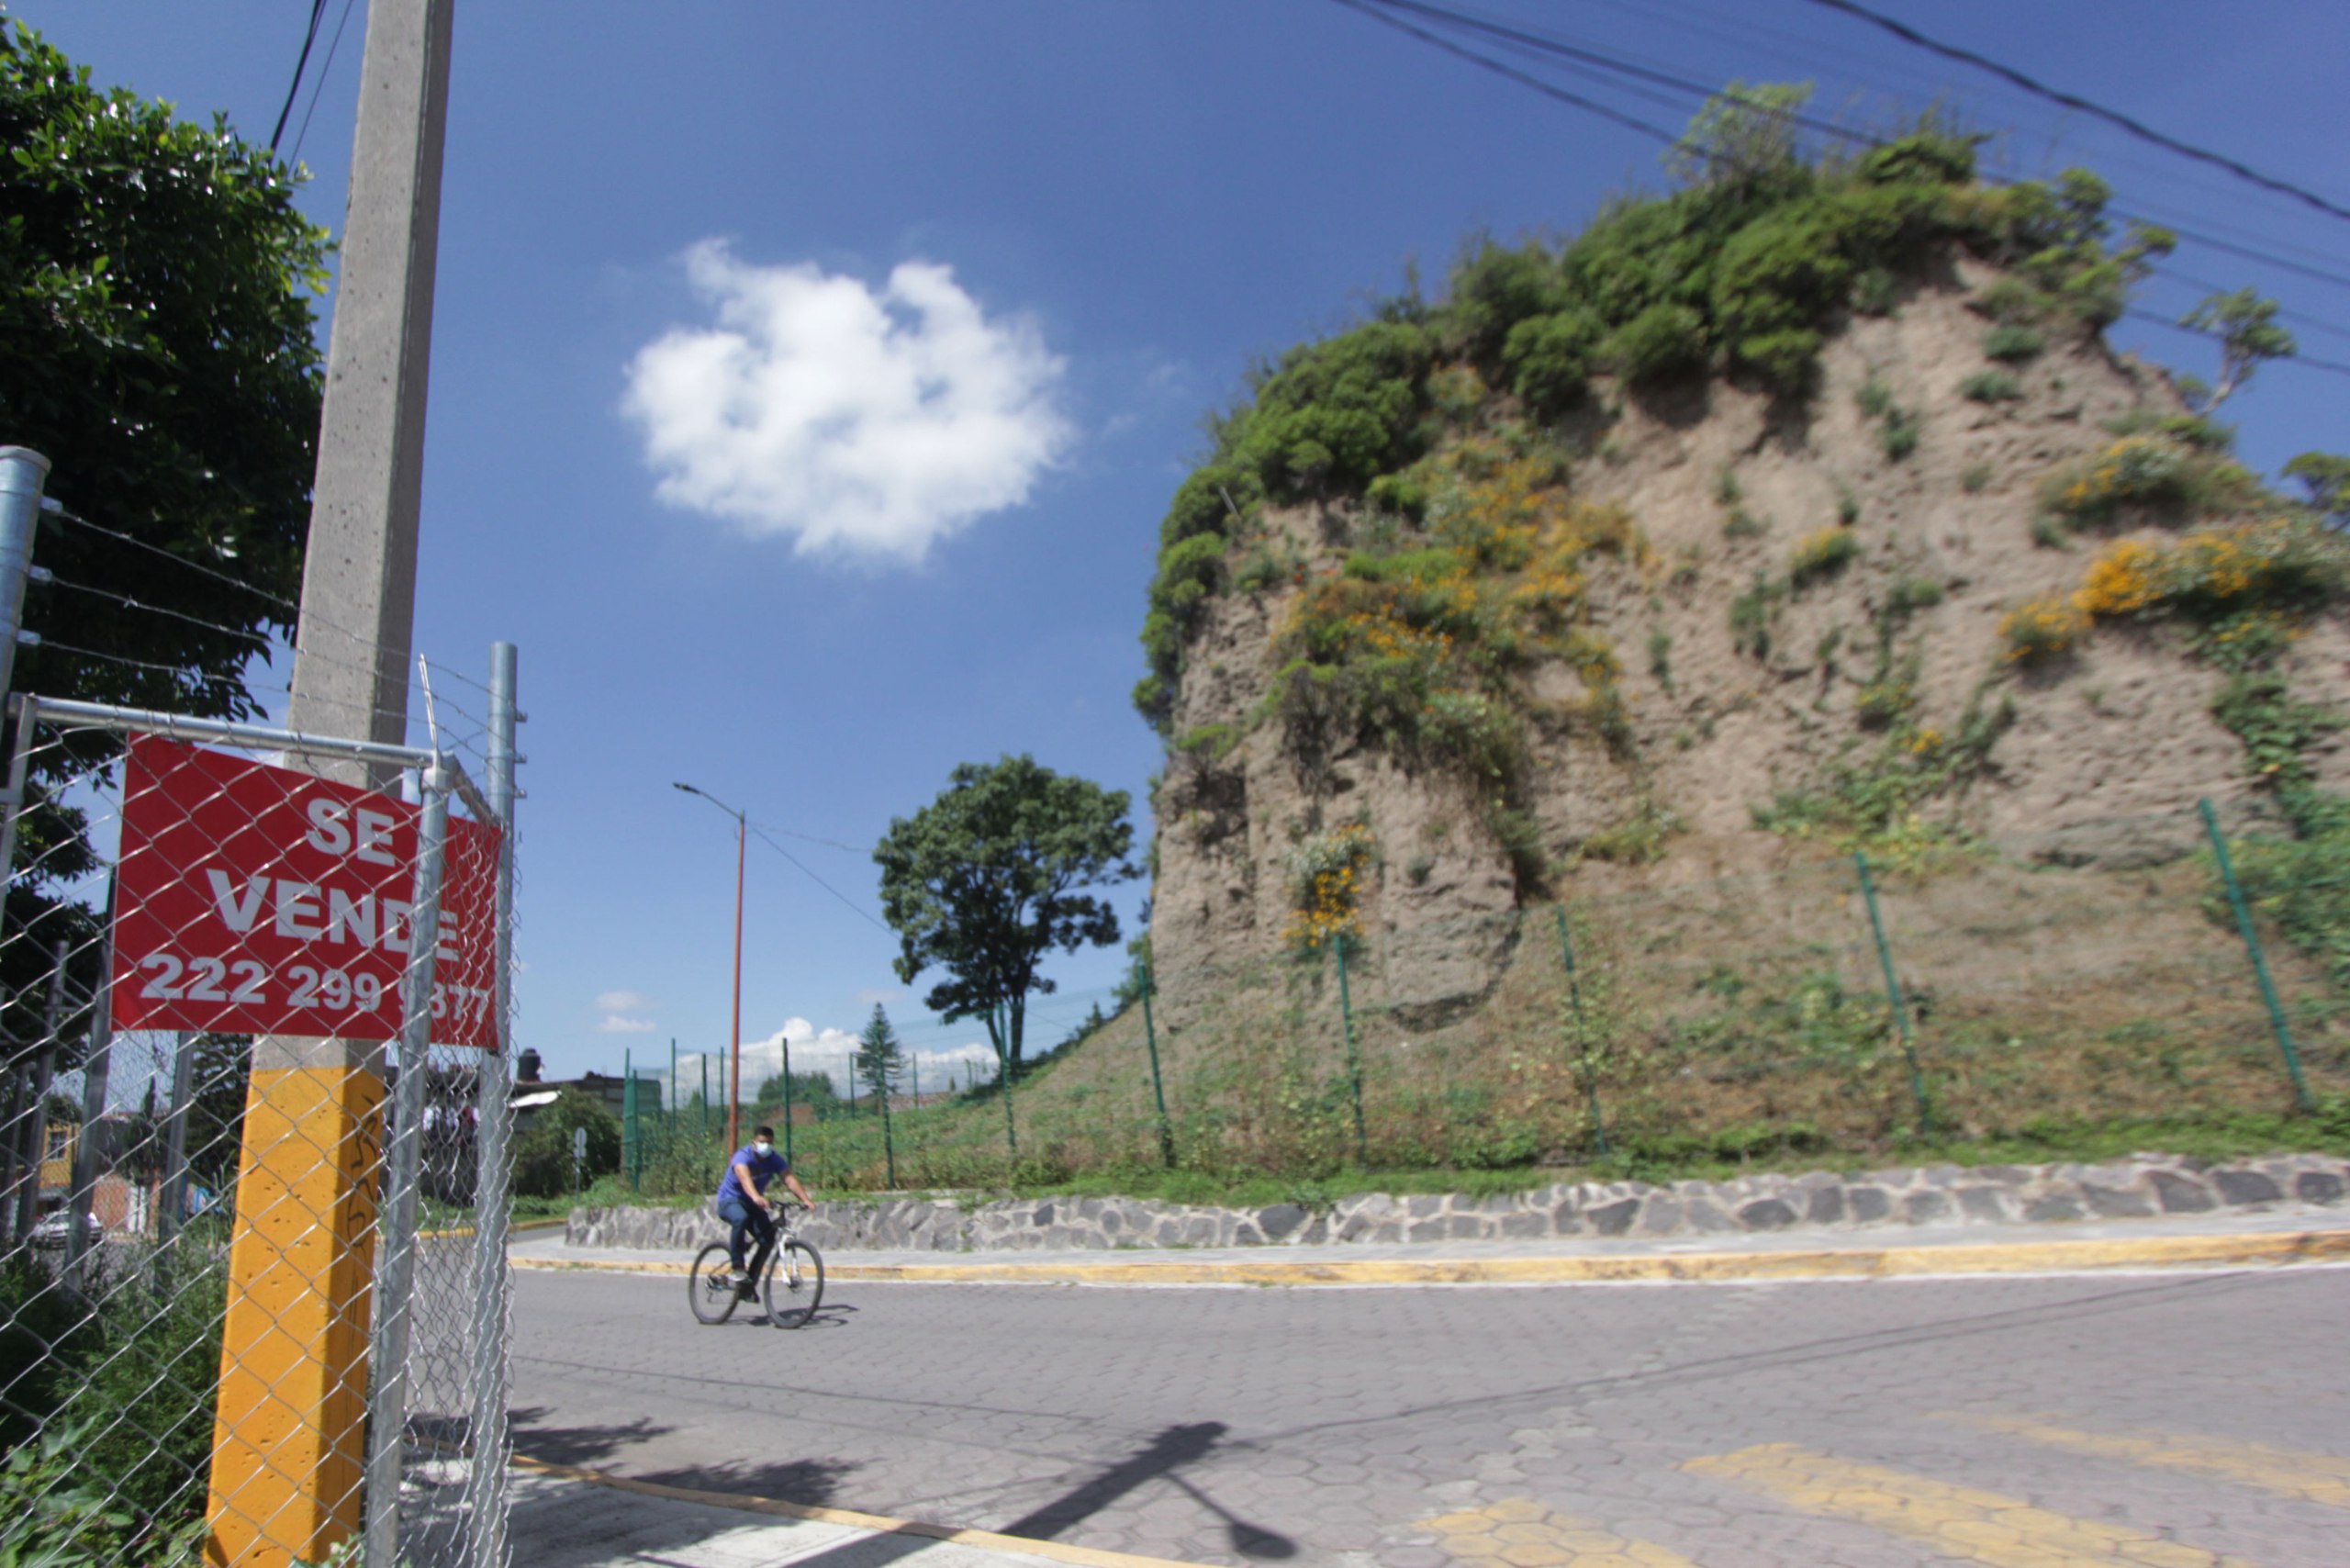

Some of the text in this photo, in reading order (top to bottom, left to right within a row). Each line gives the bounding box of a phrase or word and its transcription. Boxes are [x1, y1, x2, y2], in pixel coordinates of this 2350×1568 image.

[307, 798, 396, 867] SE
[206, 868, 460, 962] VENDE
[140, 953, 266, 1004] 222
[286, 965, 382, 1013] 299
